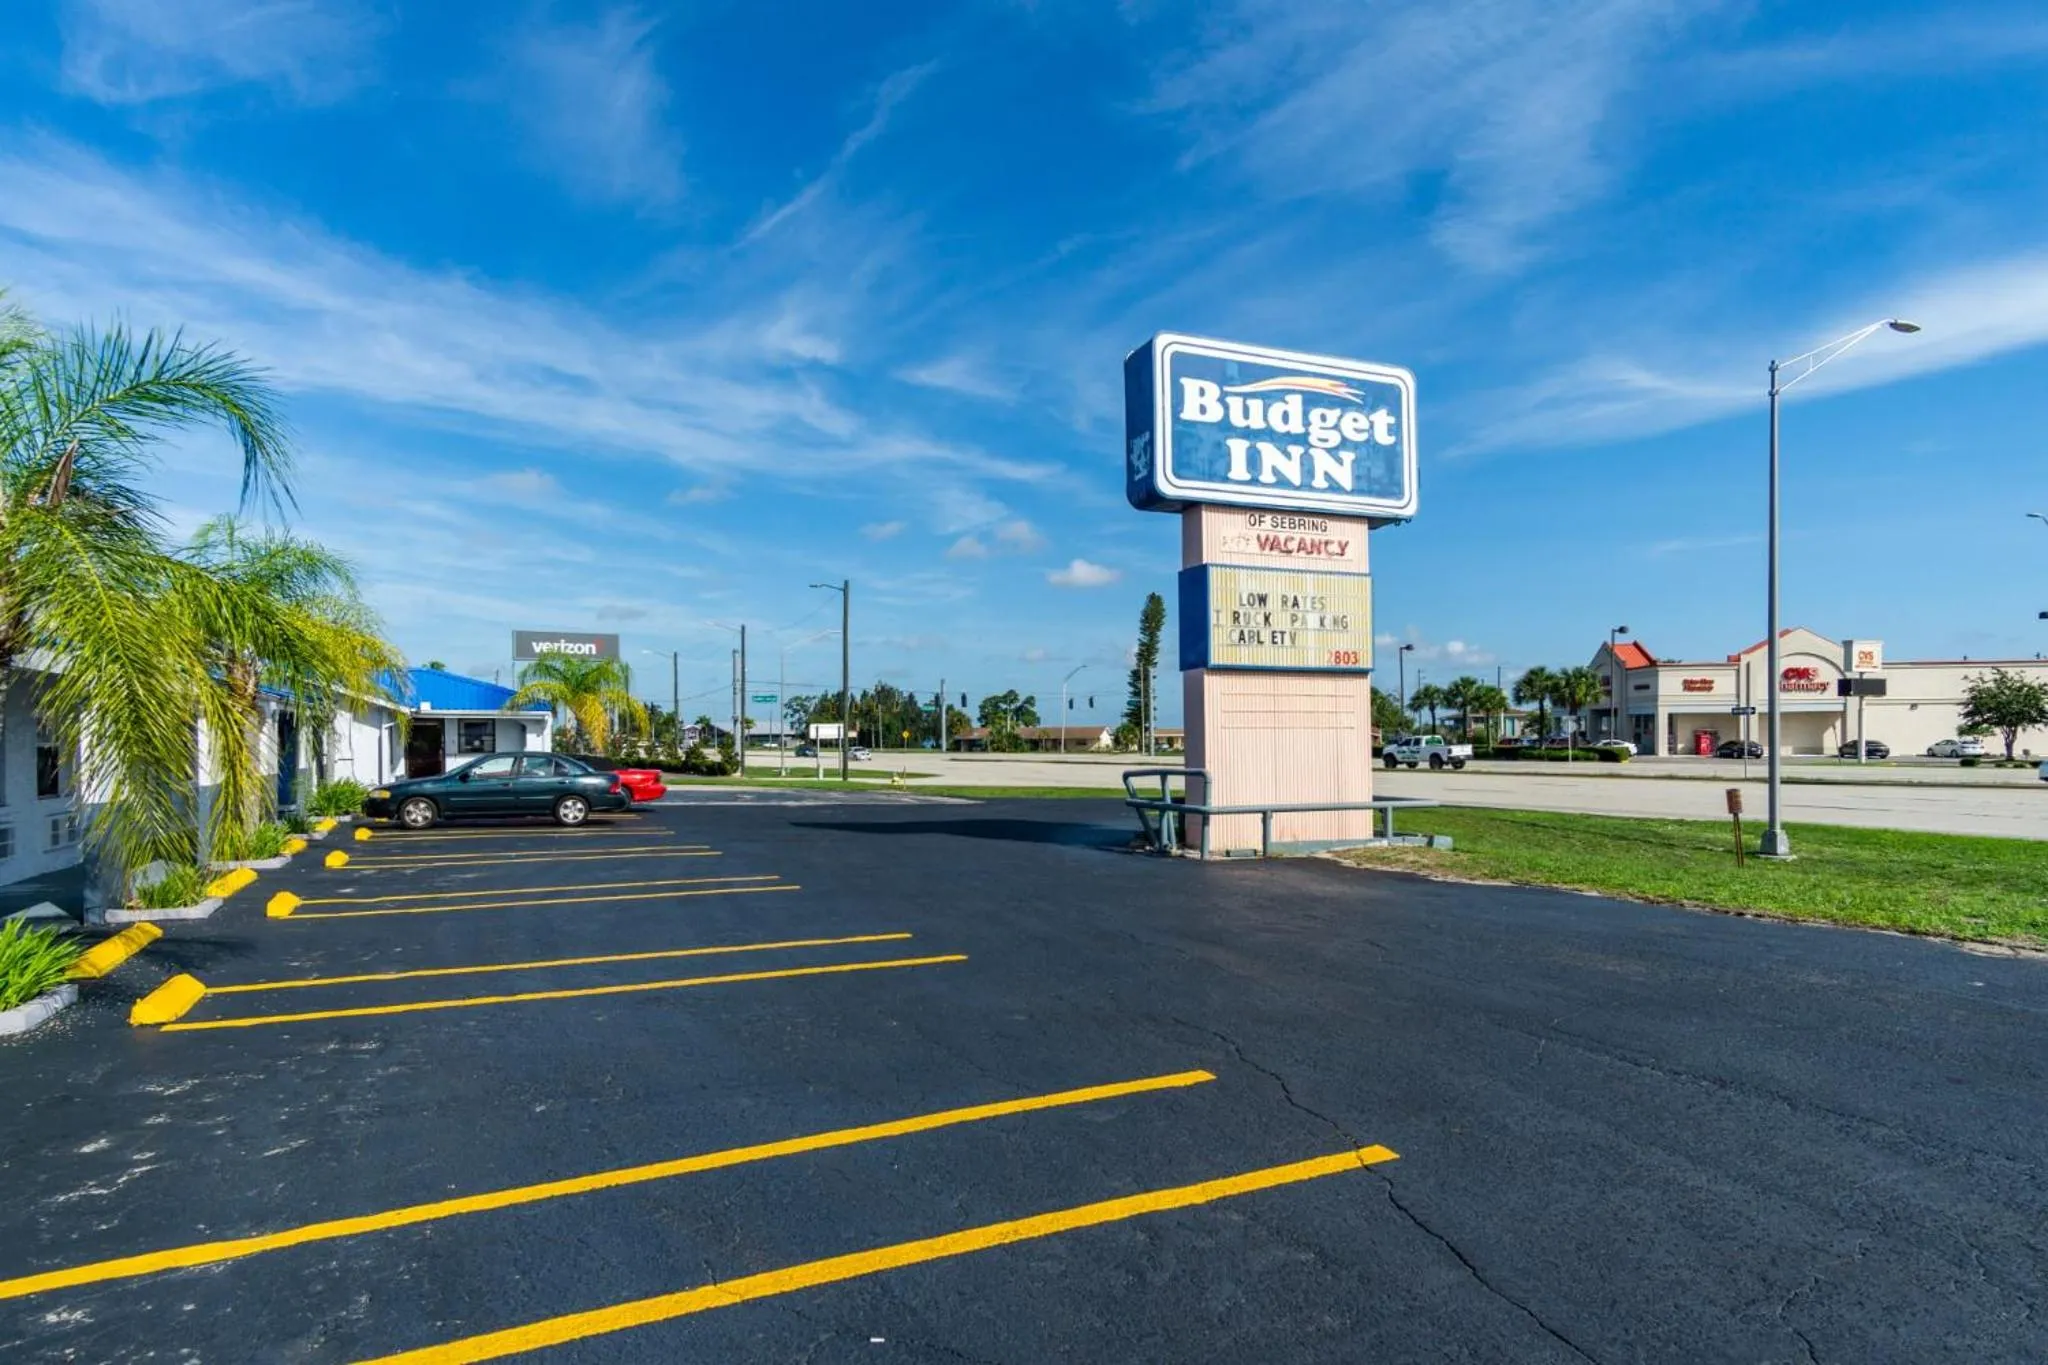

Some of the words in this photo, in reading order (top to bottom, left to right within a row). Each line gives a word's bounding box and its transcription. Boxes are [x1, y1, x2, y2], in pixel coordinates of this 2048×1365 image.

[1179, 376, 1396, 448] Budget
[1226, 438, 1356, 491] INN
[1248, 513, 1266, 527] OF
[1270, 515, 1328, 532] SEBRING
[1257, 533, 1349, 556] VACANCY
[1239, 592, 1268, 607] LOW
[531, 639, 597, 655] verizon
